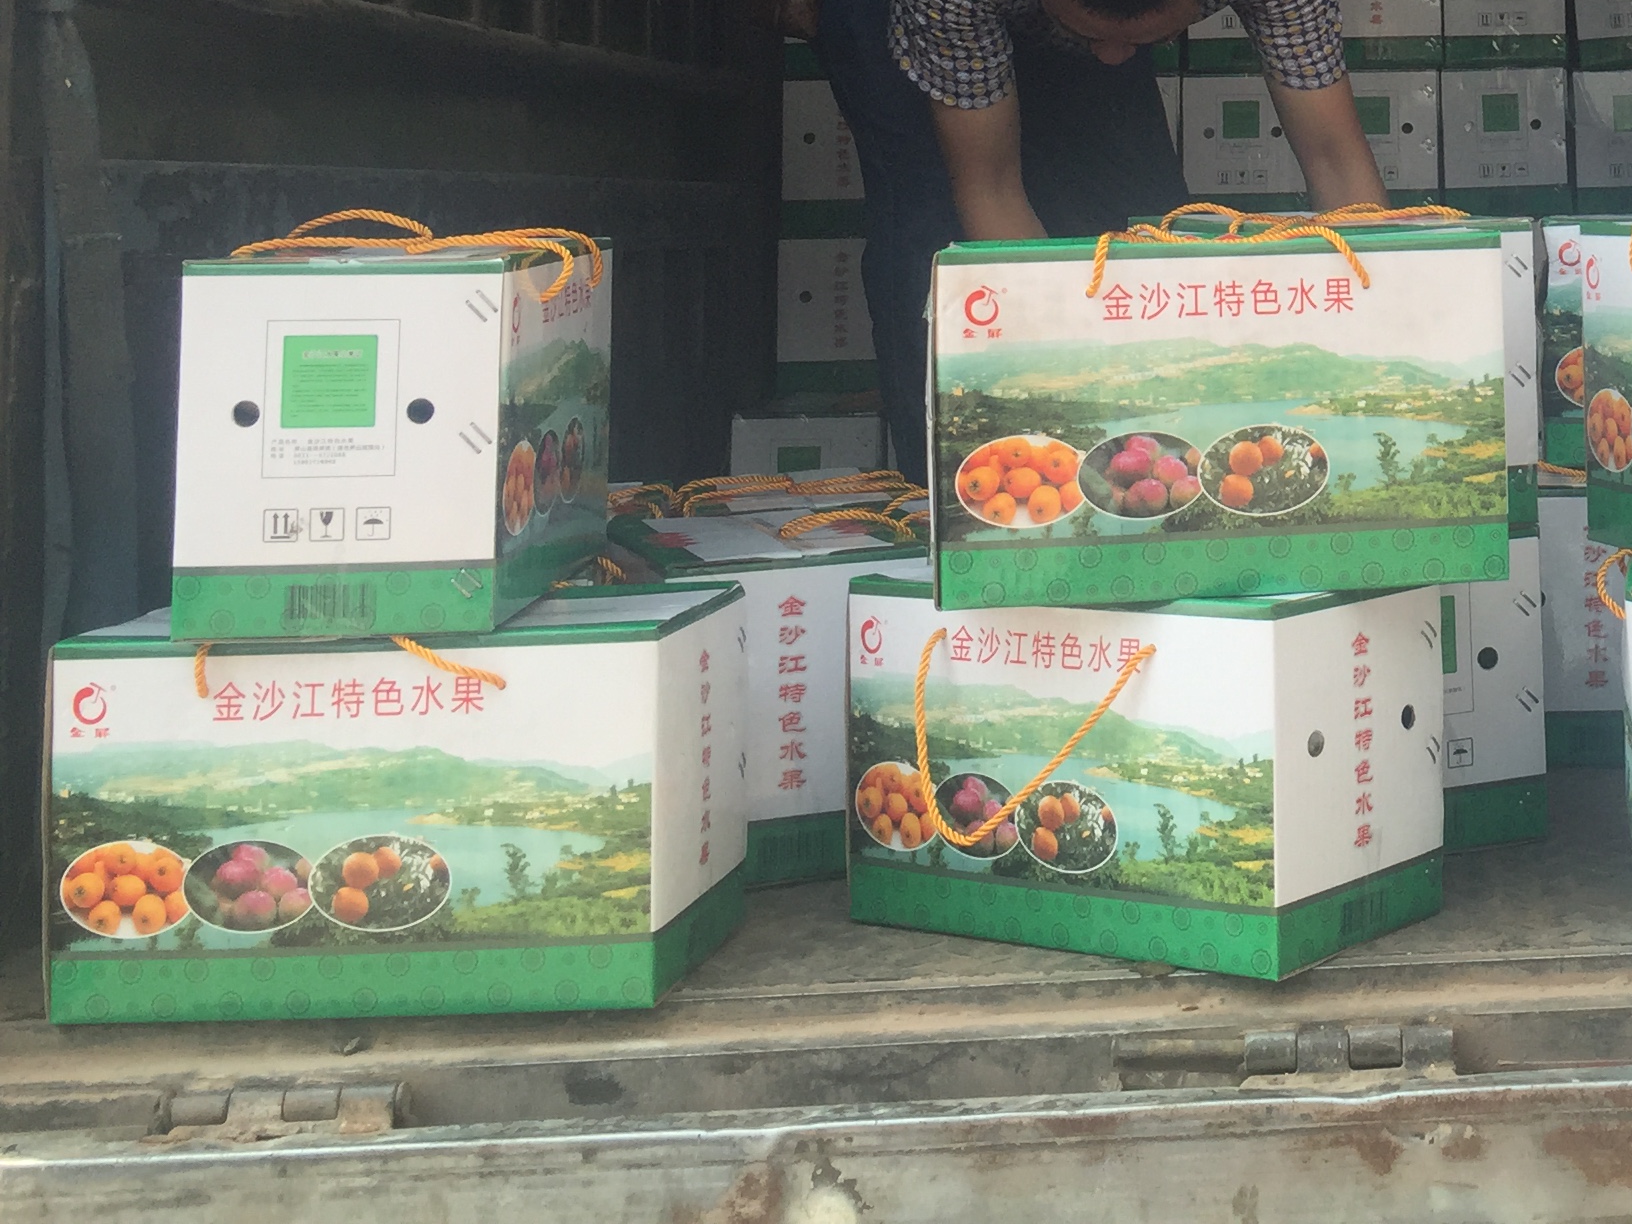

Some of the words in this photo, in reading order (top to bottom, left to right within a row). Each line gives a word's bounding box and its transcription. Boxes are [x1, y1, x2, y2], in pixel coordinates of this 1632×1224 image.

[1102, 276, 1355, 322] 金沙江特色水果
[949, 625, 1142, 675] 金沙江特色水果
[211, 677, 485, 723] 金沙江特色水果
[777, 594, 808, 791] 金沙江特色水果
[1350, 631, 1375, 850] 金沙江特色水果
